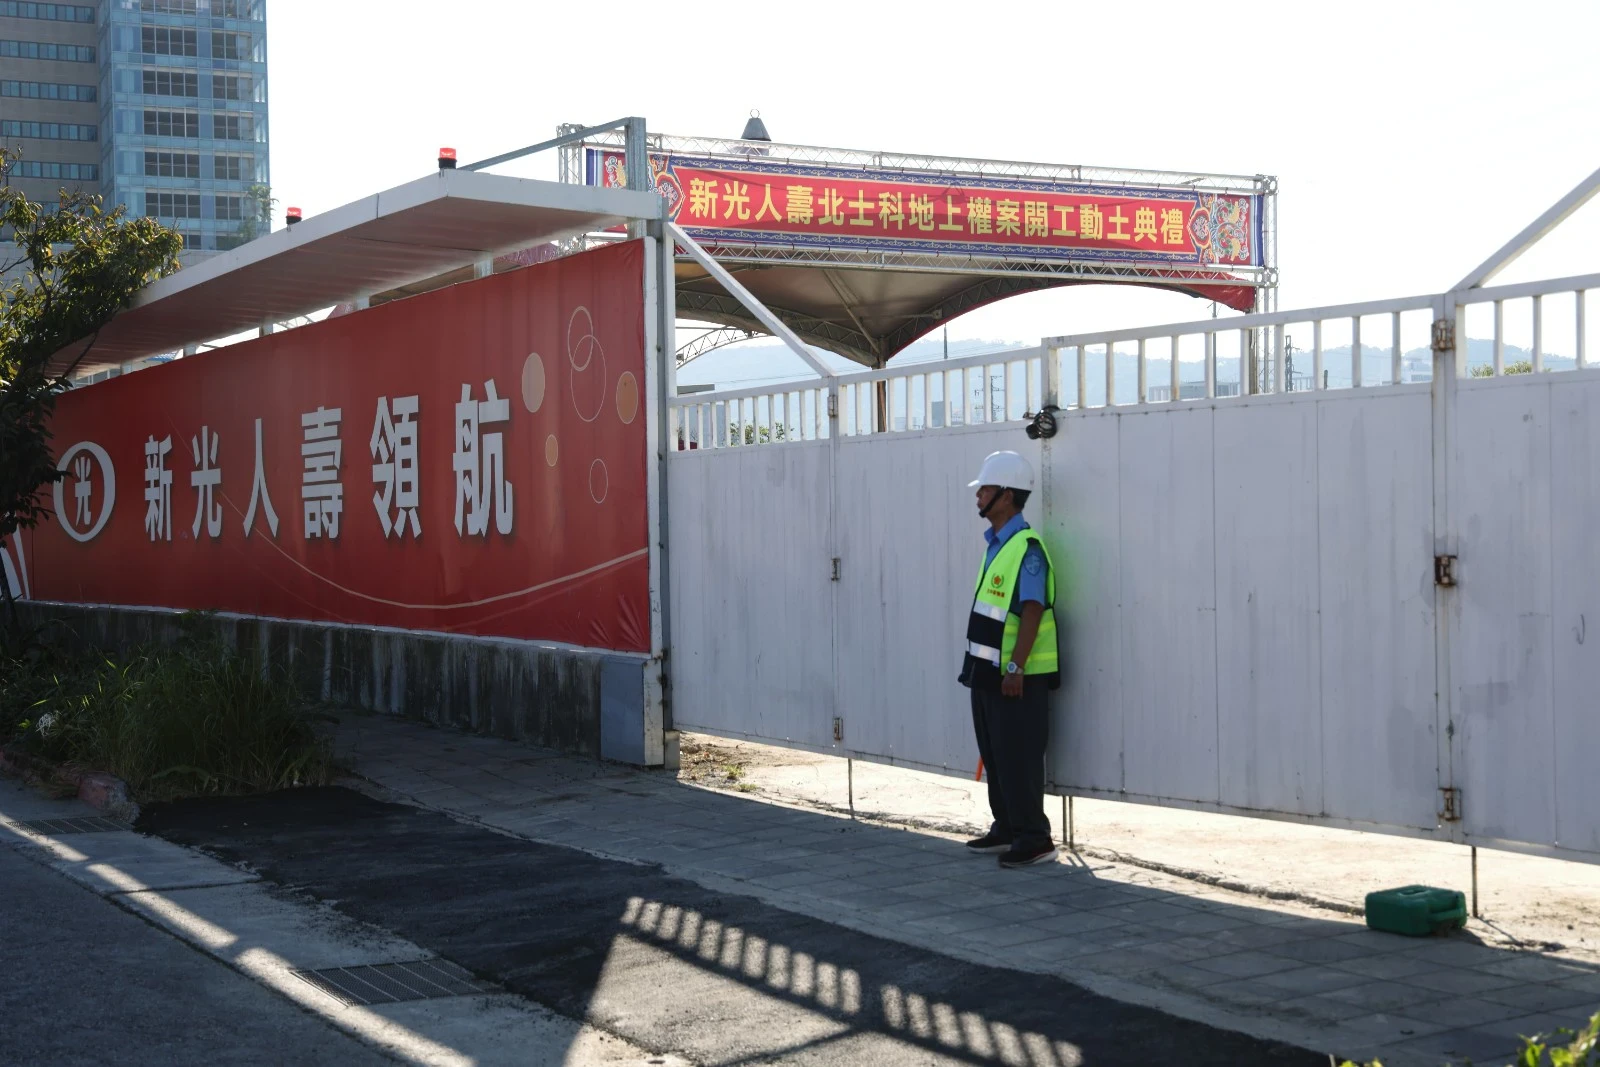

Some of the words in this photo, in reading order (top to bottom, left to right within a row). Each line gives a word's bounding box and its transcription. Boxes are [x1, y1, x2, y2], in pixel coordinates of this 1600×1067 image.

[689, 177, 1185, 245] 新光人壽北士科地上權案開工動土典禮
[74, 456, 92, 527] 光
[144, 379, 514, 542] 新光人壽領航
